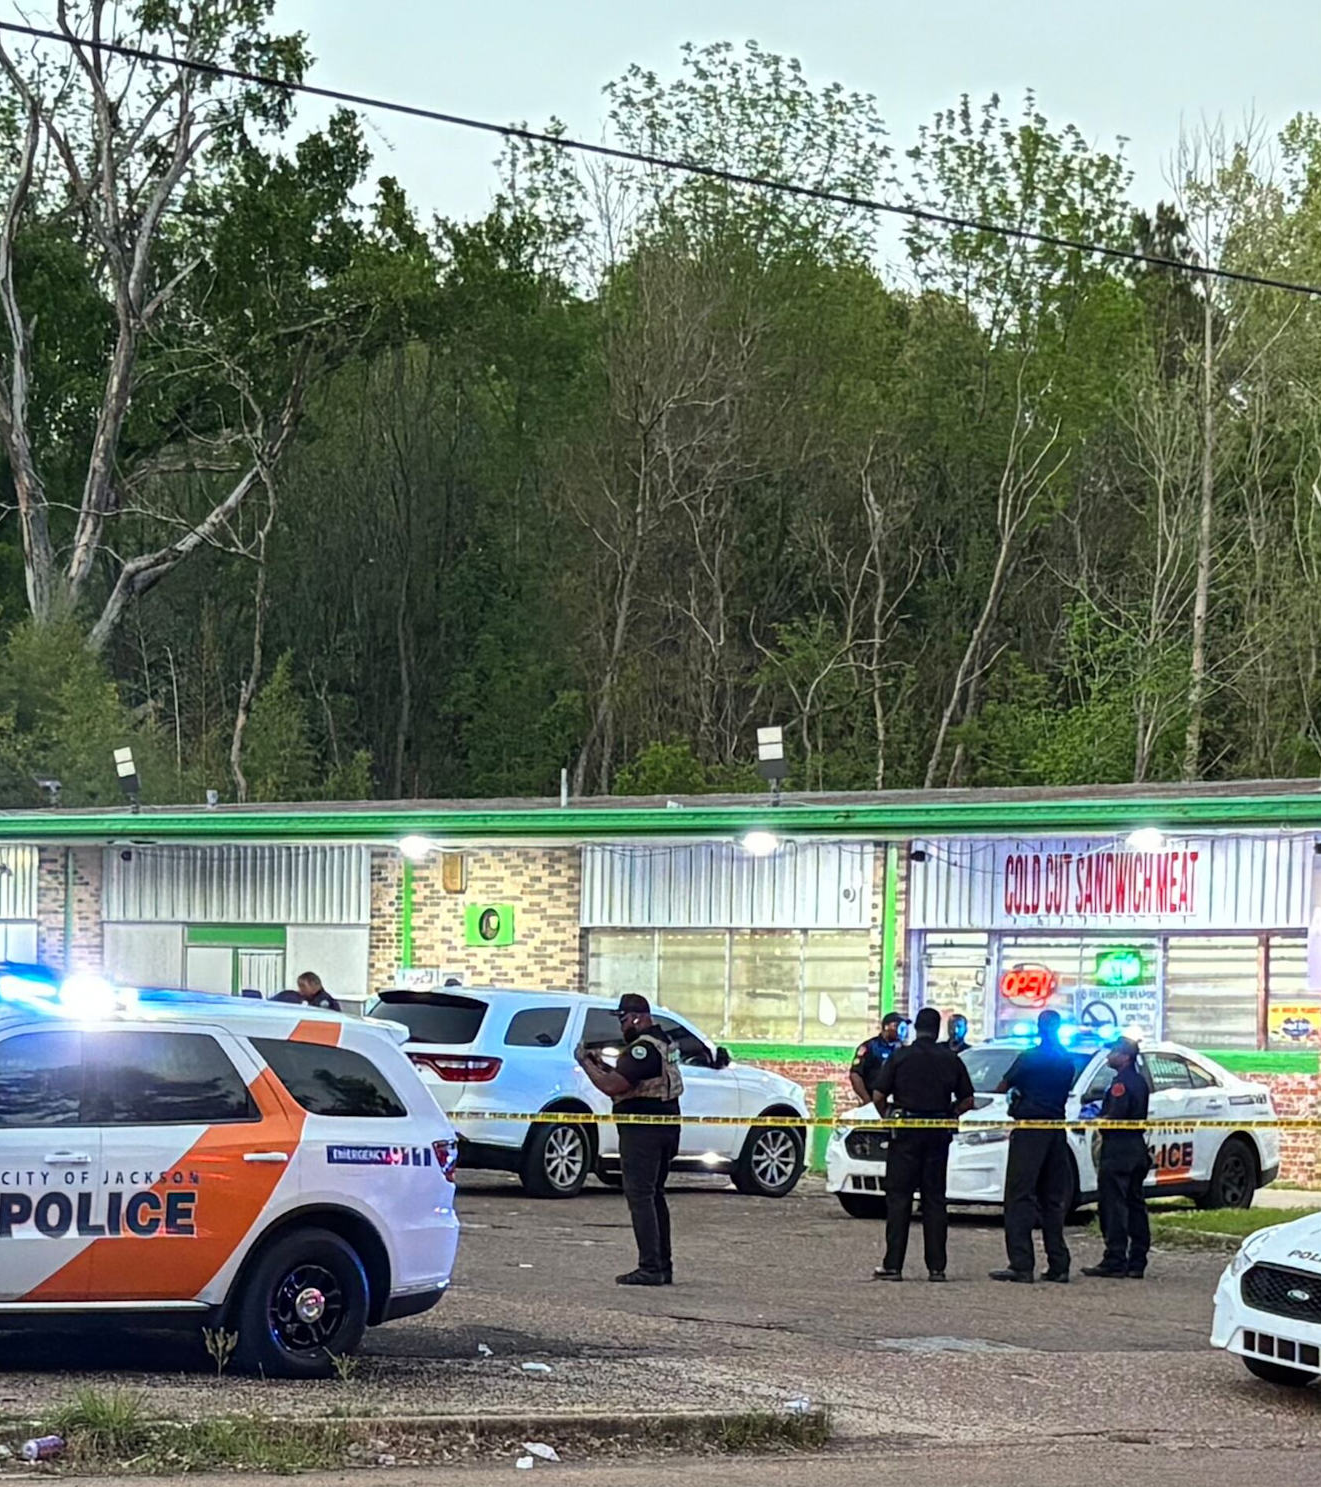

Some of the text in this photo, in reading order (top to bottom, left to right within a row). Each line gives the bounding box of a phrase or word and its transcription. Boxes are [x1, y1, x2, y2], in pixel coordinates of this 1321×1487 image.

[1004, 851, 1199, 914] COLD CUT SANDWICH MEAT
[1002, 971, 1052, 998] OPEN
[333, 1148, 387, 1161] EMERGENCY
[1, 1171, 199, 1185] CITY OF JACKSON
